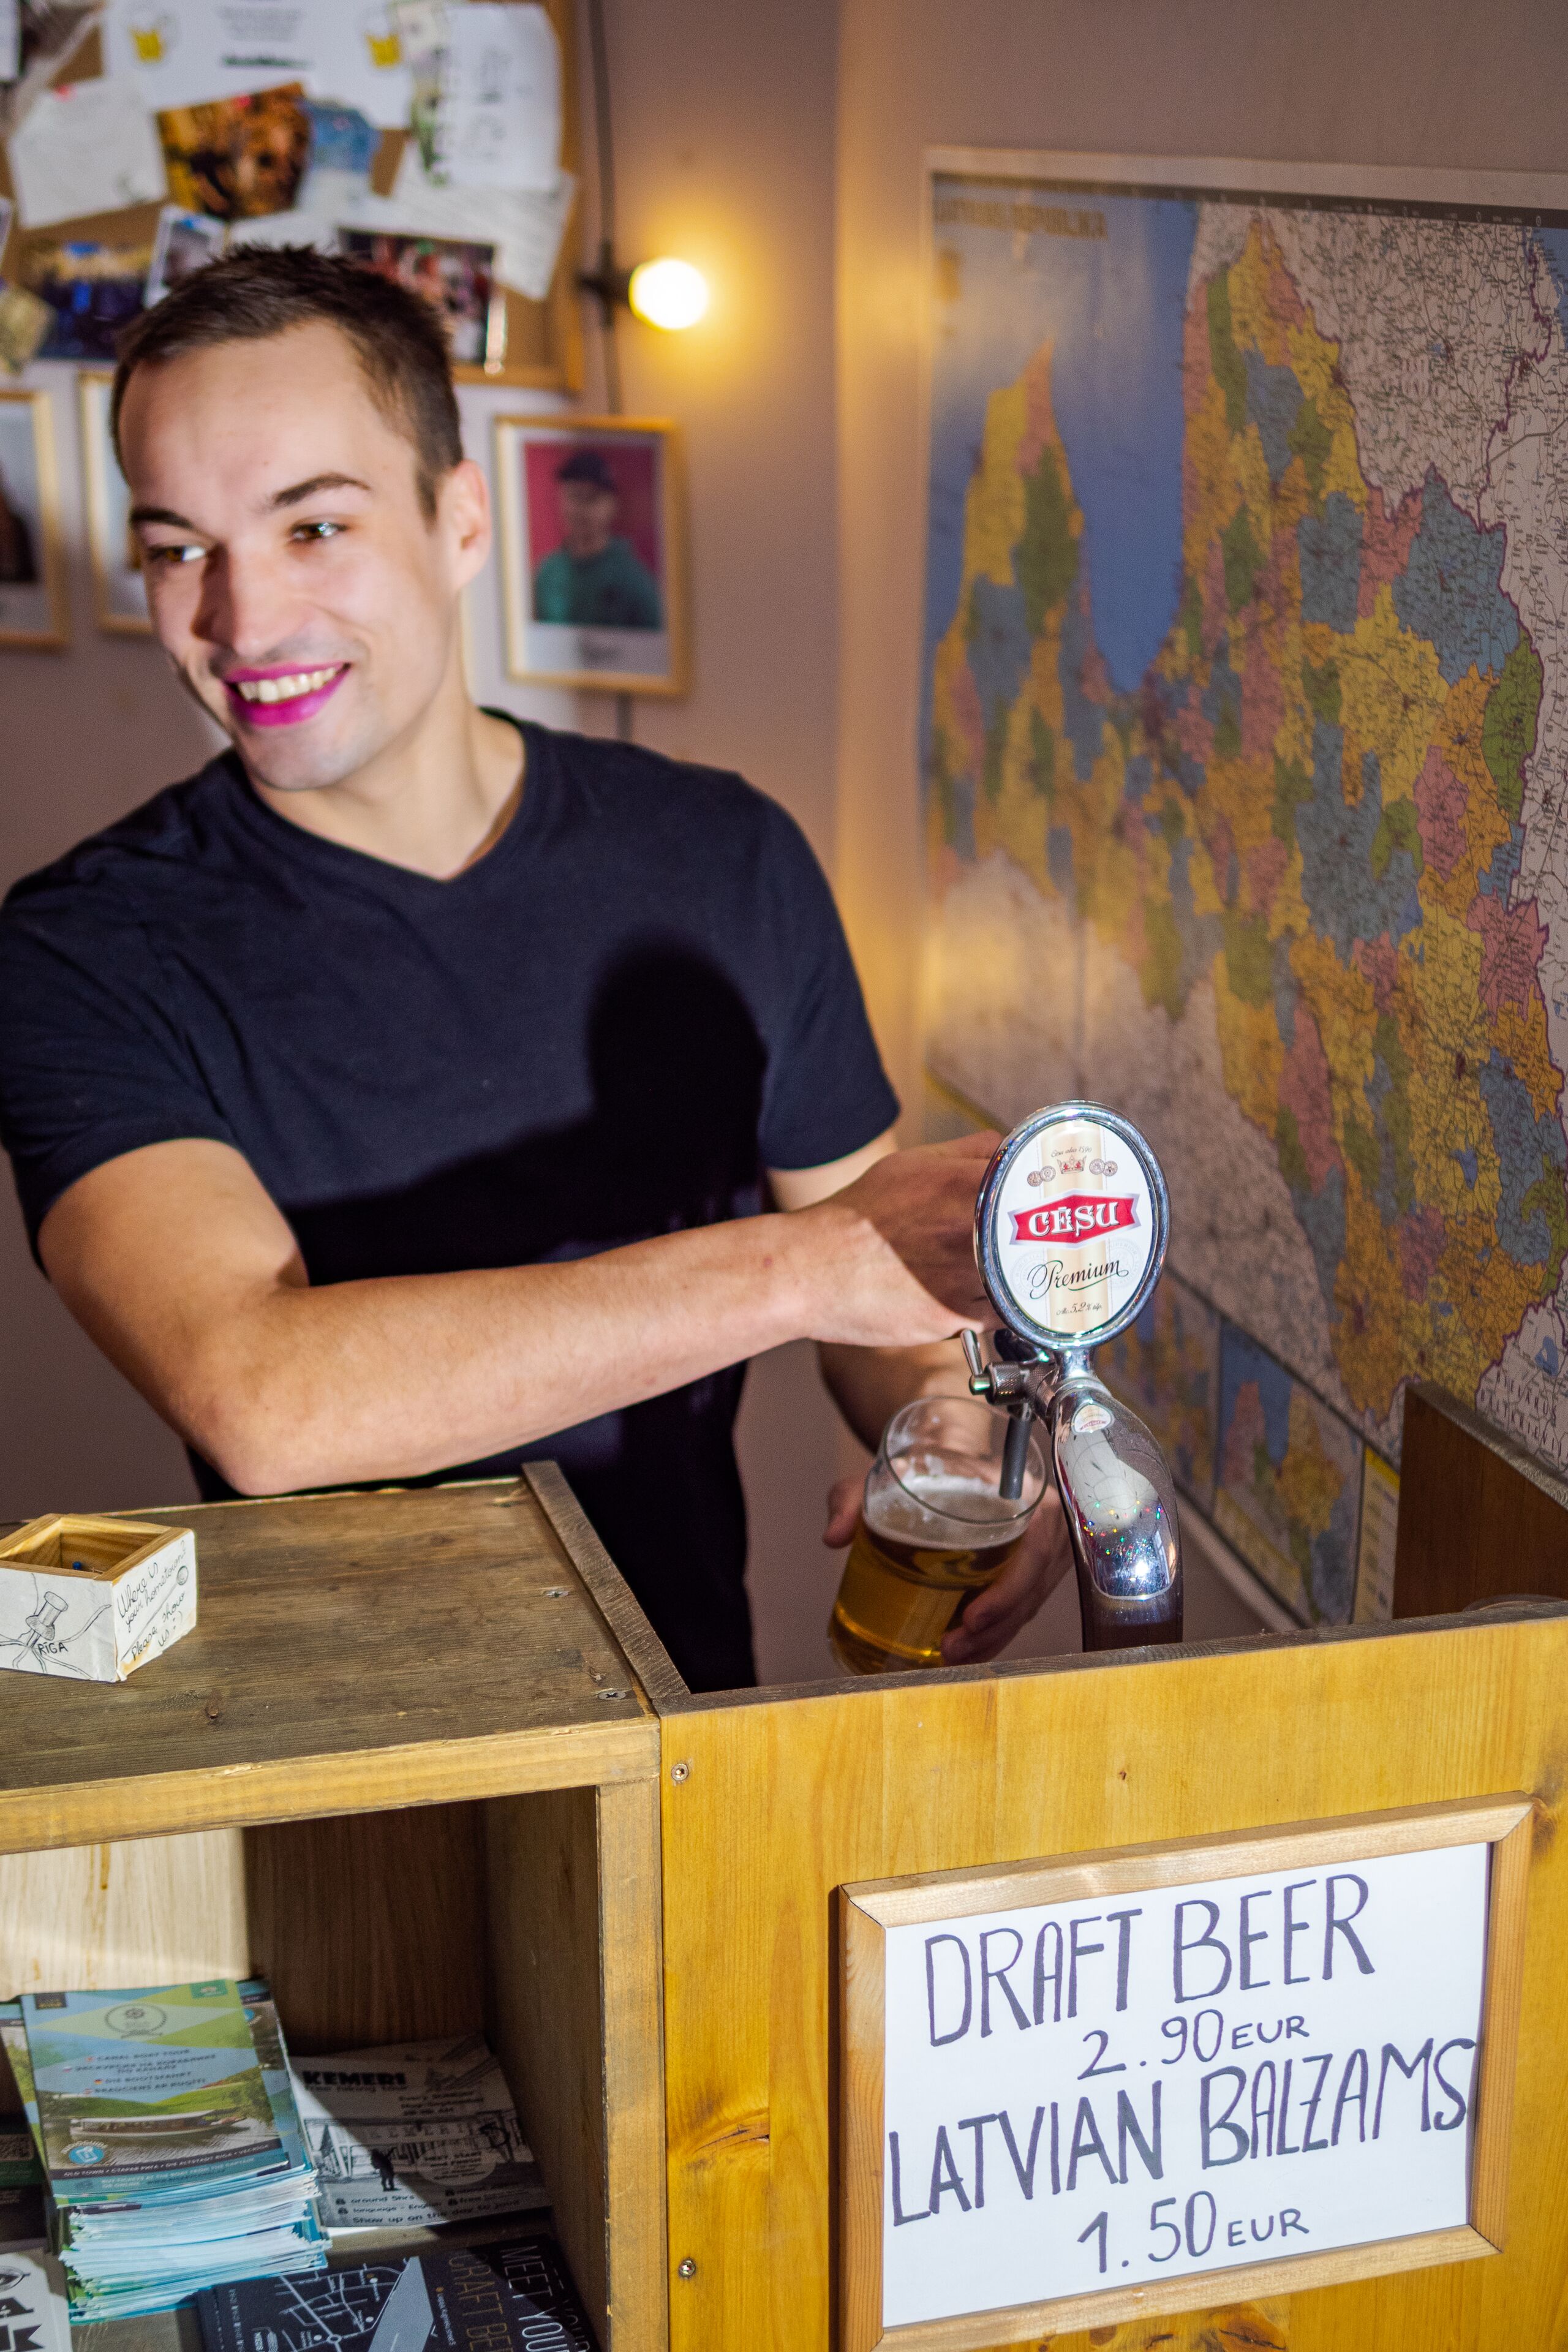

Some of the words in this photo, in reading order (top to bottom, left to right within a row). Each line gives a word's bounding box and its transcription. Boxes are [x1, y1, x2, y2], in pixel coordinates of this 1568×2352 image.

[1027, 1260, 1129, 1299] Premium
[1070, 1302, 1087, 1313] 5,2
[117, 1578, 148, 1619] Where
[148, 1561, 159, 1578] is
[161, 1593, 186, 1623] show
[125, 1603, 144, 1633] your
[157, 1629, 170, 1647] us
[924, 1908, 1143, 2046] DRAFT
[1172, 1873, 1376, 2004] BEER
[1076, 2009, 1225, 2079] 2.90
[1231, 2014, 1310, 2051] EUR
[888, 2080, 1163, 2226] LATVIAN
[1200, 2038, 1477, 2170] BALZAMS
[1077, 2189, 1217, 2272] 1.50
[1227, 2208, 1310, 2247] EUR
[448, 2253, 503, 2316] CRAFT
[500, 2245, 553, 2299] MEET
[518, 2306, 571, 2352] YOU
